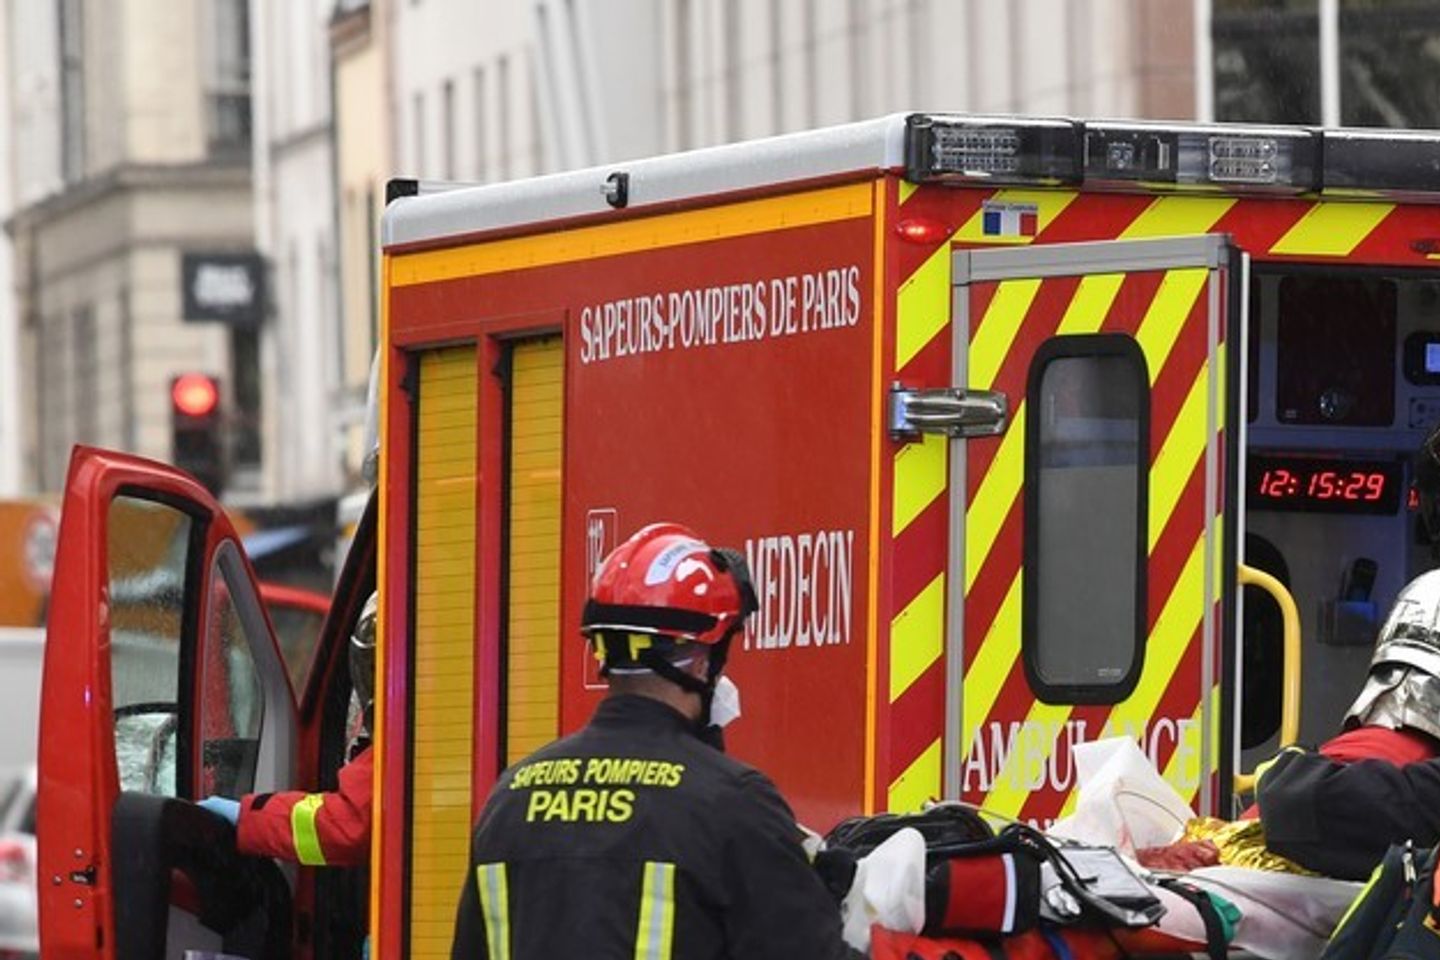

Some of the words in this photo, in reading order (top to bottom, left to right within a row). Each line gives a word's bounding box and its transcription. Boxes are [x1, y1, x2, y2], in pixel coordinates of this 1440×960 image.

[580, 281, 766, 364] SAPEURS-POMPIERS
[770, 277, 797, 336] DE
[802, 266, 859, 331] PARIS
[1260, 470, 1385, 499] 12:15:29
[744, 531, 854, 650] MEDECIN
[509, 758, 582, 790] SAPEURS
[583, 758, 685, 788] POMPIERS
[963, 718, 1201, 793] AMBUCE
[525, 789, 635, 823] PARIS
